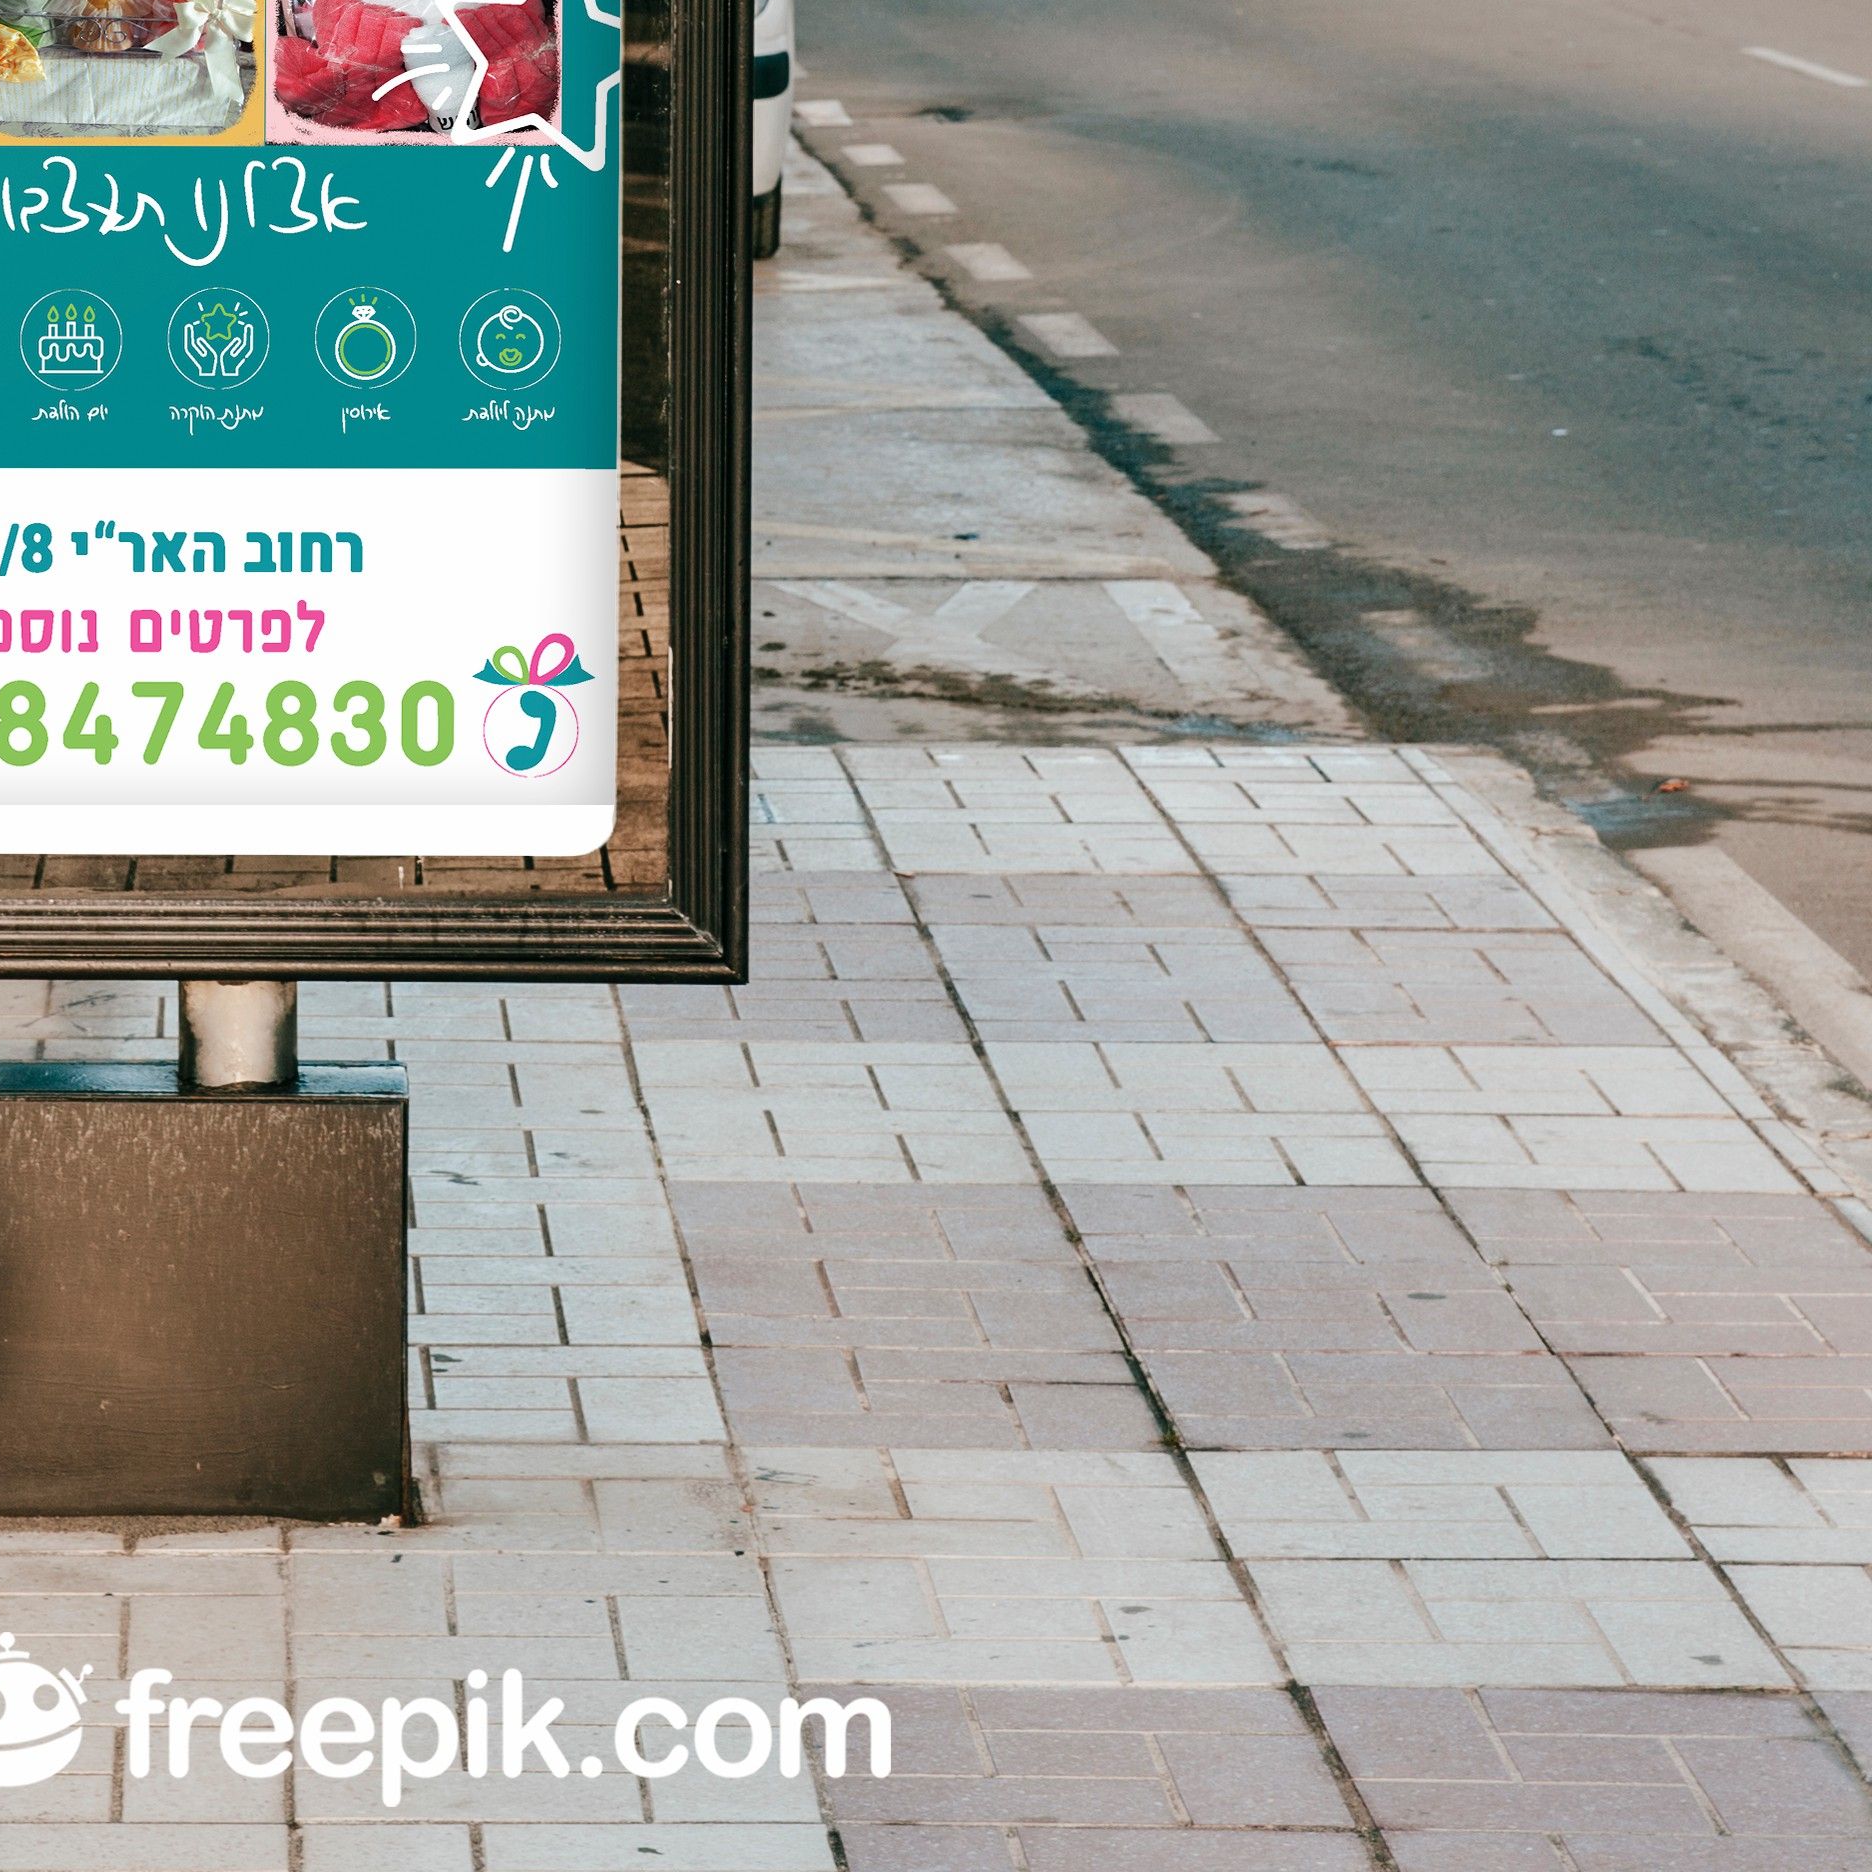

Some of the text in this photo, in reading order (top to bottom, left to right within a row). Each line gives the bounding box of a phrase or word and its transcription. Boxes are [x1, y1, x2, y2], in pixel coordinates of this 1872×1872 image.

[164, 157, 367, 266] אצלנו
[87, 405, 109, 421] יום
[170, 404, 216, 436] הוקרה
[341, 404, 391, 434] אירוסין
[513, 406, 556, 431] מתנה
[244, 532, 364, 573] רחוב
[130, 600, 326, 653] לפרטים
